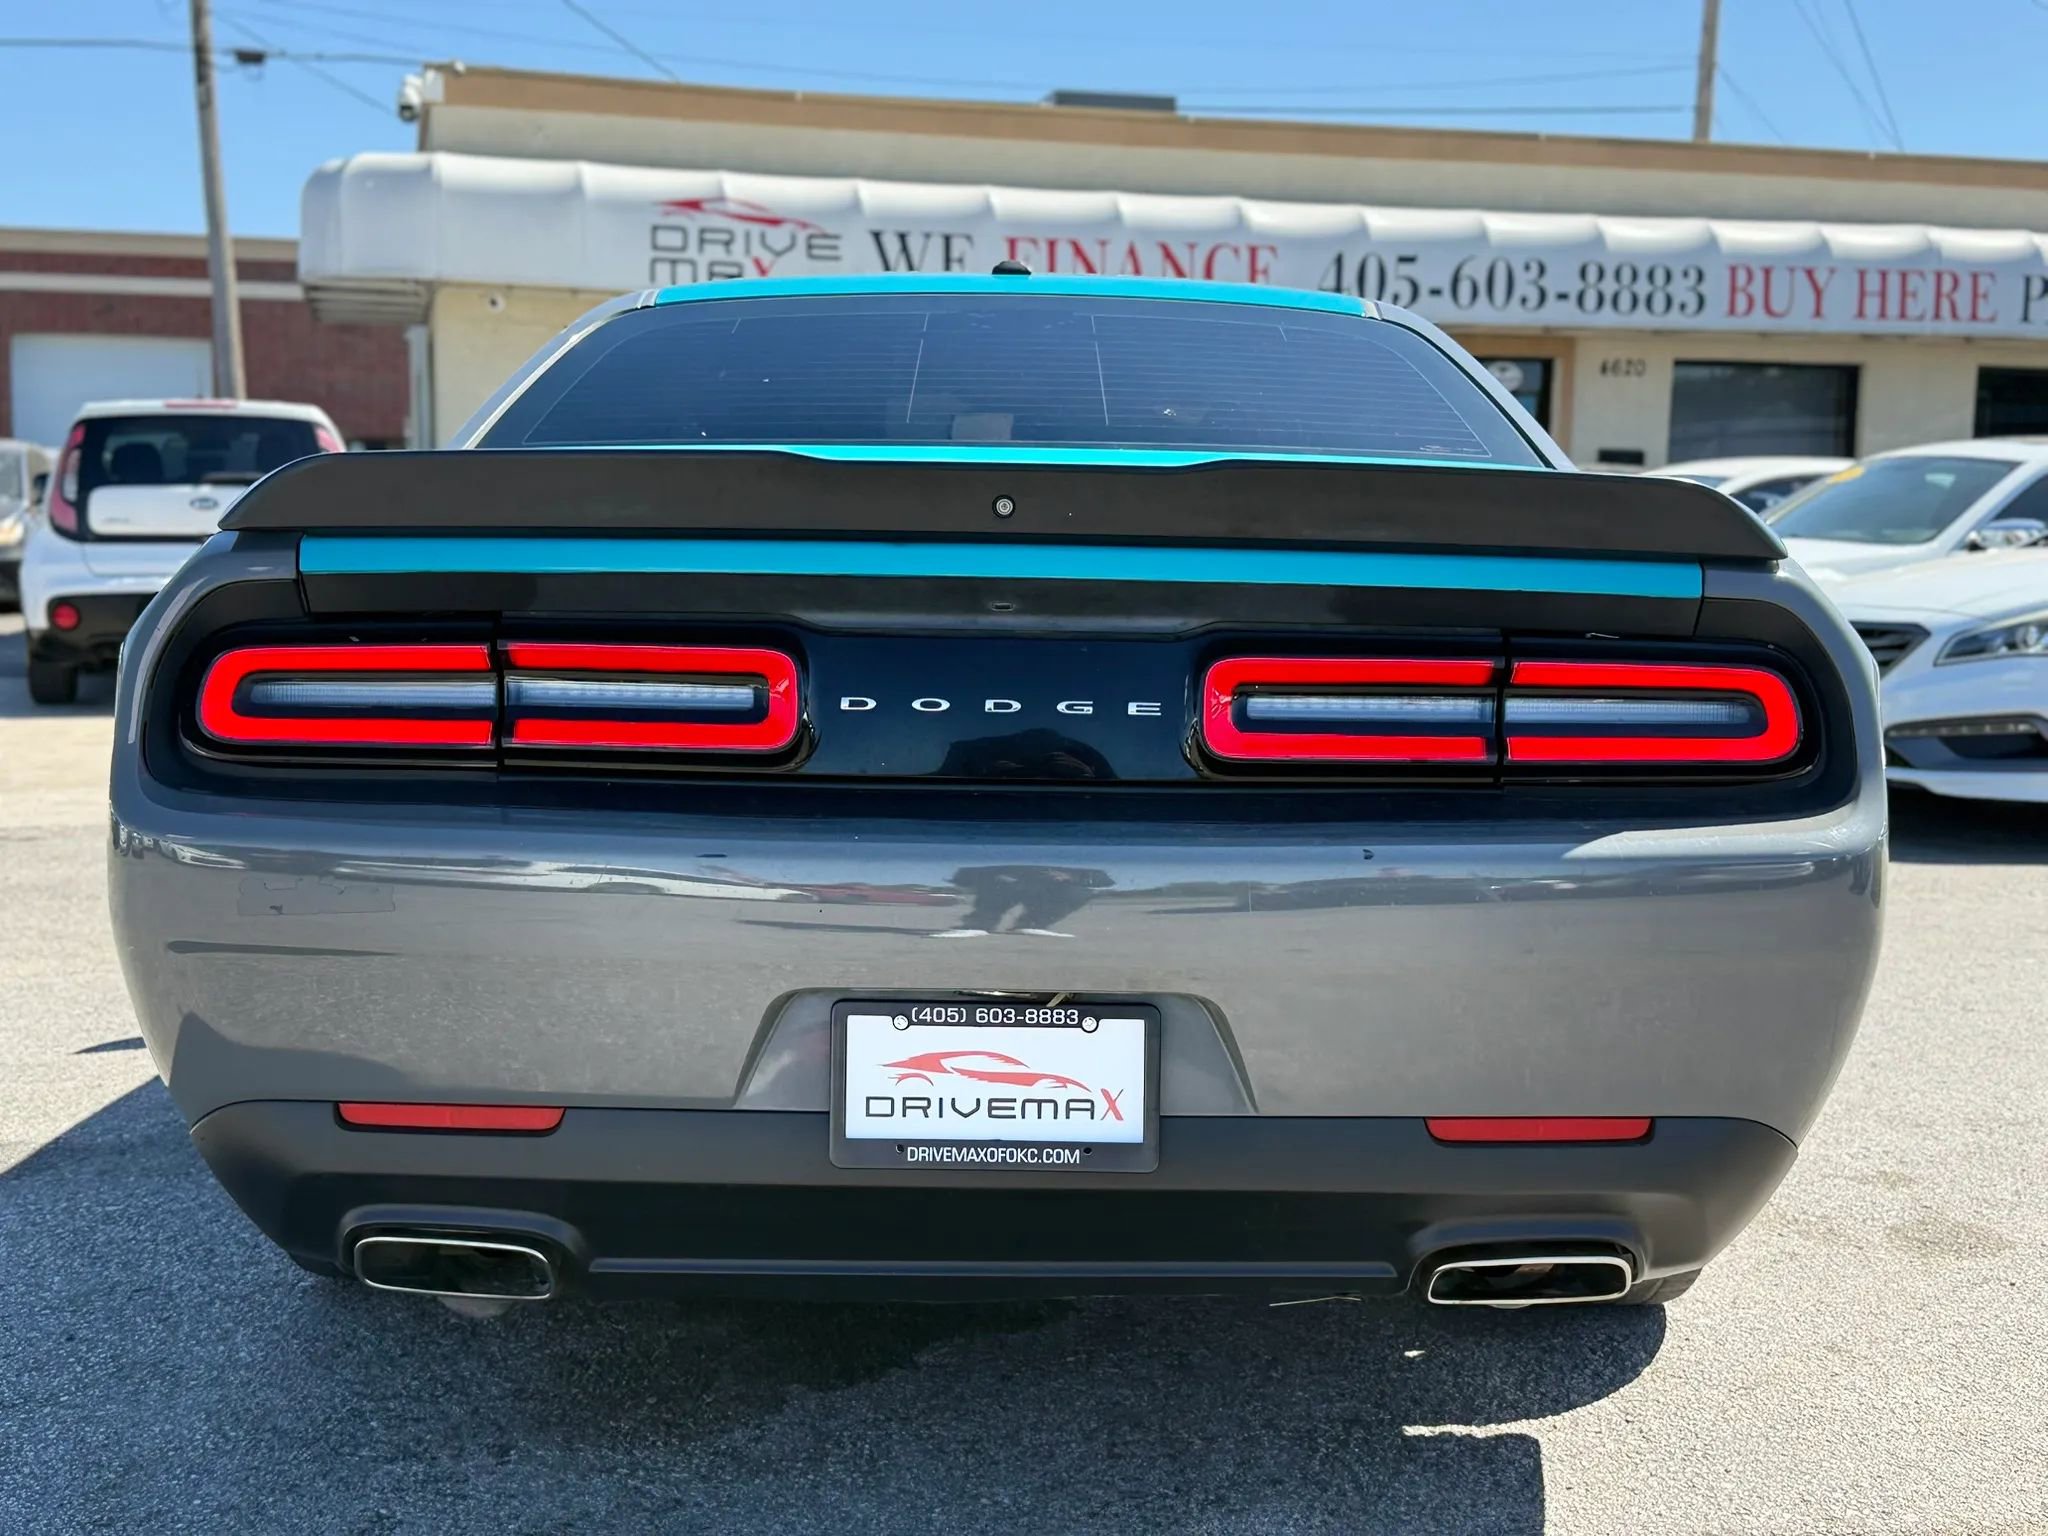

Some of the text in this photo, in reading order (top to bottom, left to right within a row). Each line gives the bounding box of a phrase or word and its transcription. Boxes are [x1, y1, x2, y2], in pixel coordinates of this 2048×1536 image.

[651, 224, 842, 261] DRIVE
[1004, 236, 1278, 284] FINANCE
[1317, 252, 1706, 318] 405-603-8883
[1726, 263, 1837, 320] BUY
[1853, 268, 1999, 323] HERE
[840, 696, 1162, 716] DODGE
[911, 1007, 1079, 1025] (405) 603-8883
[865, 1088, 1124, 1121] DRIVEMAX
[907, 1146, 1080, 1164] DRIVEMAXOFOKC.COM
